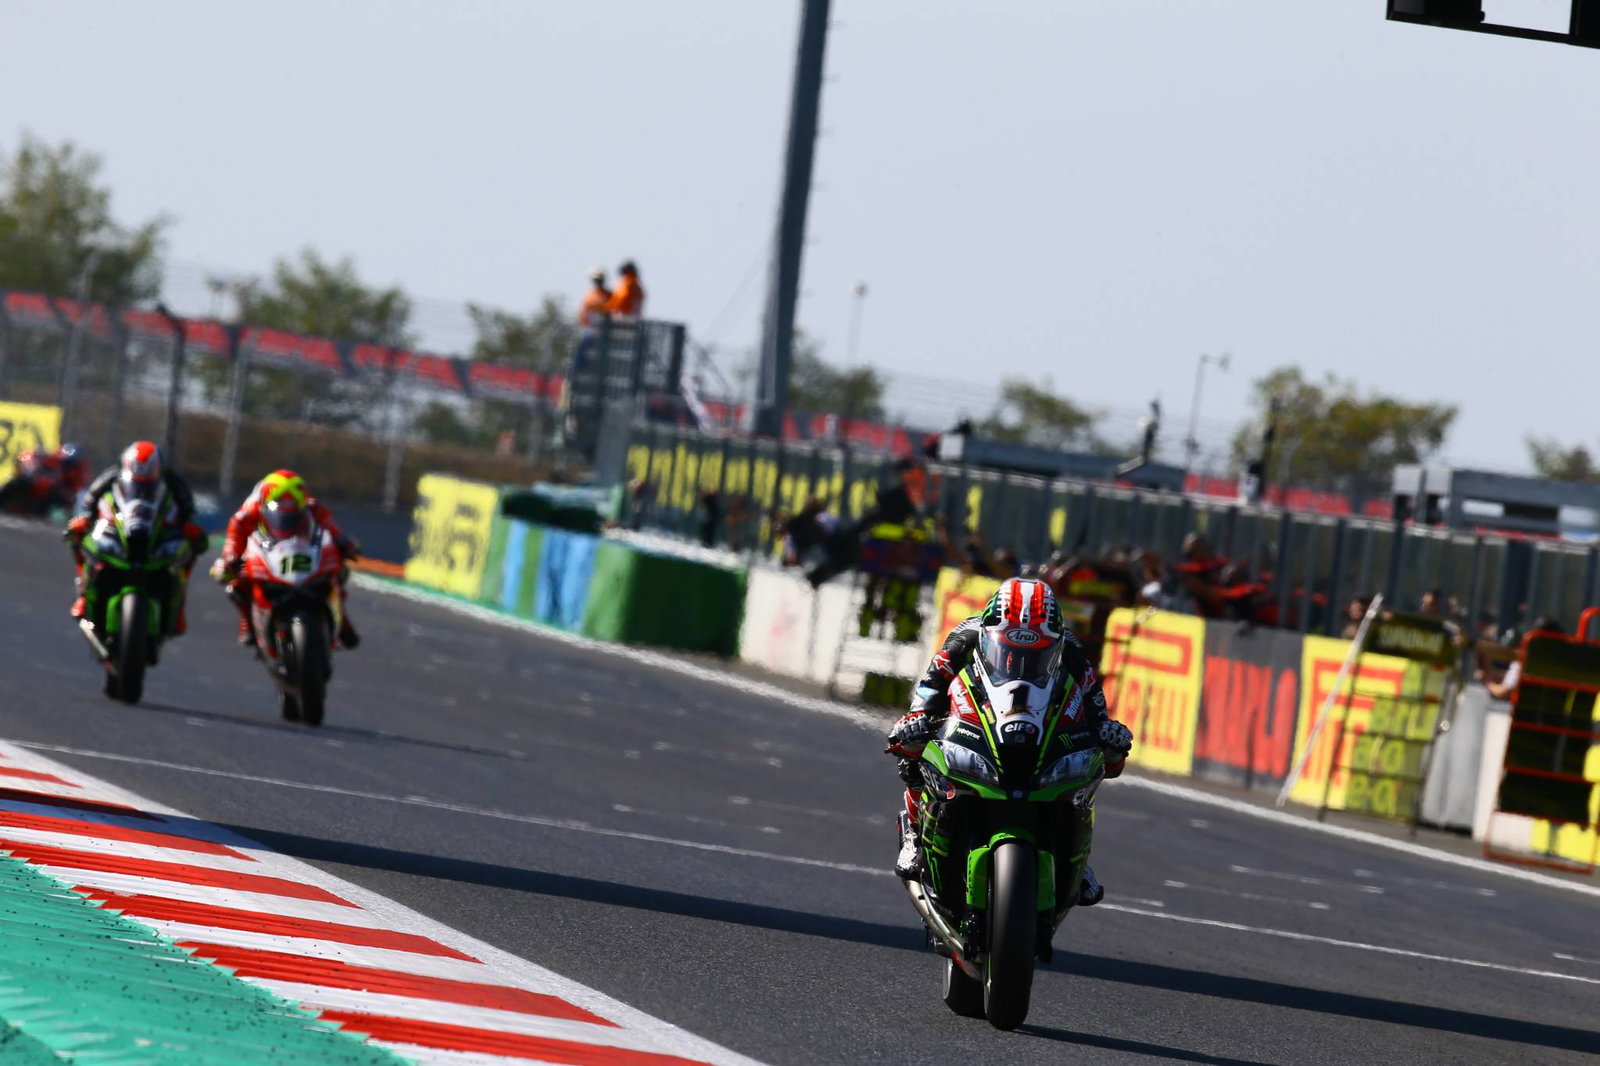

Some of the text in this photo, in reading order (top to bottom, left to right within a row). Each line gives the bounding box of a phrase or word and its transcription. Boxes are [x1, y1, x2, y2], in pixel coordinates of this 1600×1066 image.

[280, 553, 313, 575] 12
[1009, 631, 1037, 641] Arai
[1006, 683, 1031, 714] 1
